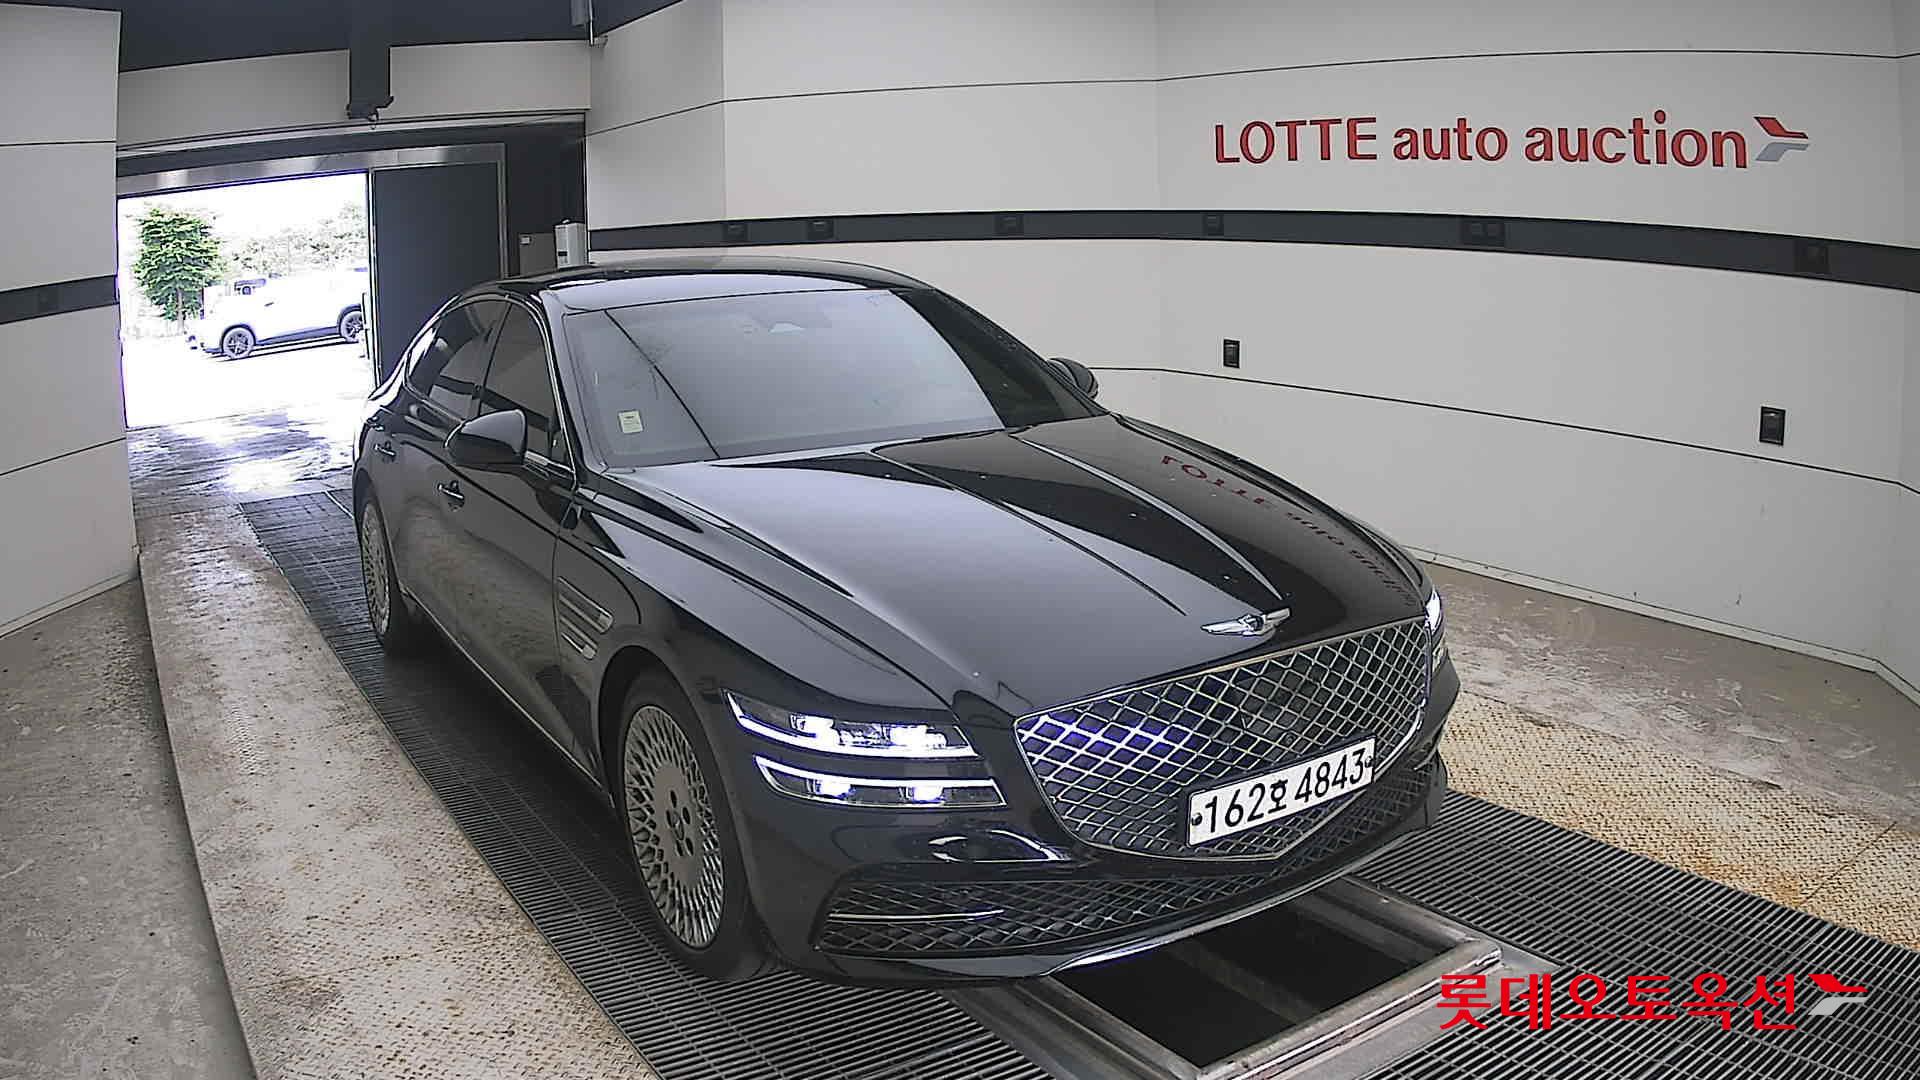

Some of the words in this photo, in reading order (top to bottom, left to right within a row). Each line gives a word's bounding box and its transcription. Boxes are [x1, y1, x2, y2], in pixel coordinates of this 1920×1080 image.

[1214, 116, 1377, 164] LOTTE
[1392, 117, 1509, 162] auto
[1524, 109, 1749, 169] auction
[1294, 747, 1367, 804] 4843
